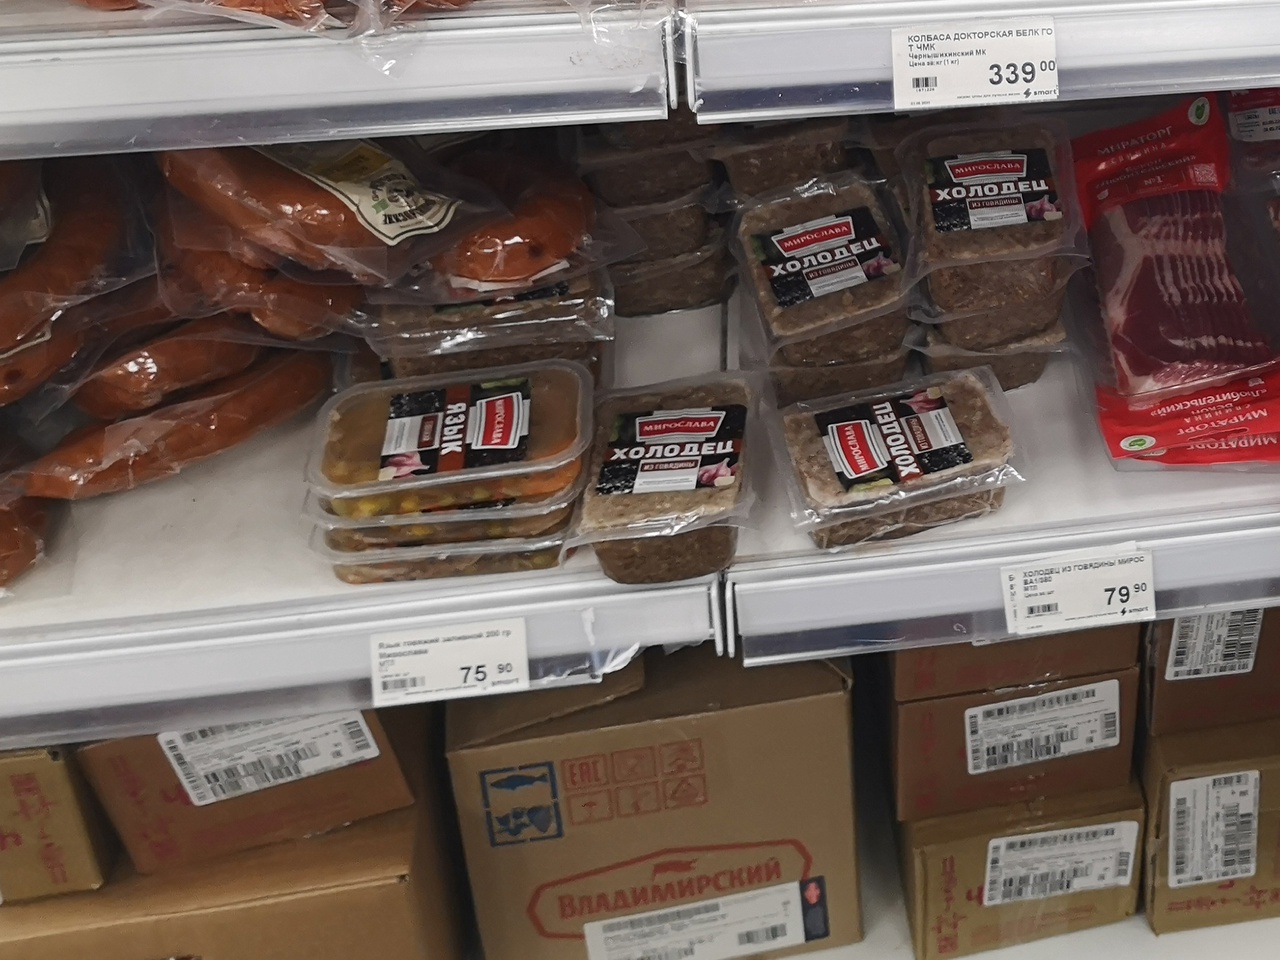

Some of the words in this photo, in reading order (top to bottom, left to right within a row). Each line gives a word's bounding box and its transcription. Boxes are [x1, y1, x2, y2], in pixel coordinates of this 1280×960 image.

[908, 33, 952, 43] КОЛБАСА
[953, 31, 1014, 41] ДОКТОРСКАЯ
[1016, 29, 1040, 37] БЕЛК
[1042, 28, 1053, 36] ГО
[917, 43, 936, 51] ЧМК
[909, 50, 974, 61] Чернышихинский
[989, 62, 1036, 86] 339
[1040, 60, 1056, 72] 00
[1097, 126, 1172, 155] МИРАТОРГ
[954, 161, 1022, 175] МИРОСЛАВА
[936, 178, 1050, 201] ХОЛОДЕЦ
[783, 224, 849, 249] МИРОСЛАВА
[770, 237, 882, 278] ХОЛОДЕЦ
[440, 402, 467, 456] ЯЗЫК
[643, 420, 715, 432] МИРОСЛАВА
[1177, 408, 1268, 436] МИРАТОРГ
[610, 440, 734, 461] ХОЛОДЕЦ
[872, 401, 921, 477] ХОЛОДЕЦ
[1023, 567, 1061, 578] ХОЛОДЕЦ
[1073, 560, 1116, 572] ГОВЯДИНЫ
[1118, 556, 1145, 565] МИРОС
[1104, 585, 1131, 606] 79
[1133, 582, 1147, 593] 90
[460, 664, 487, 684] 75
